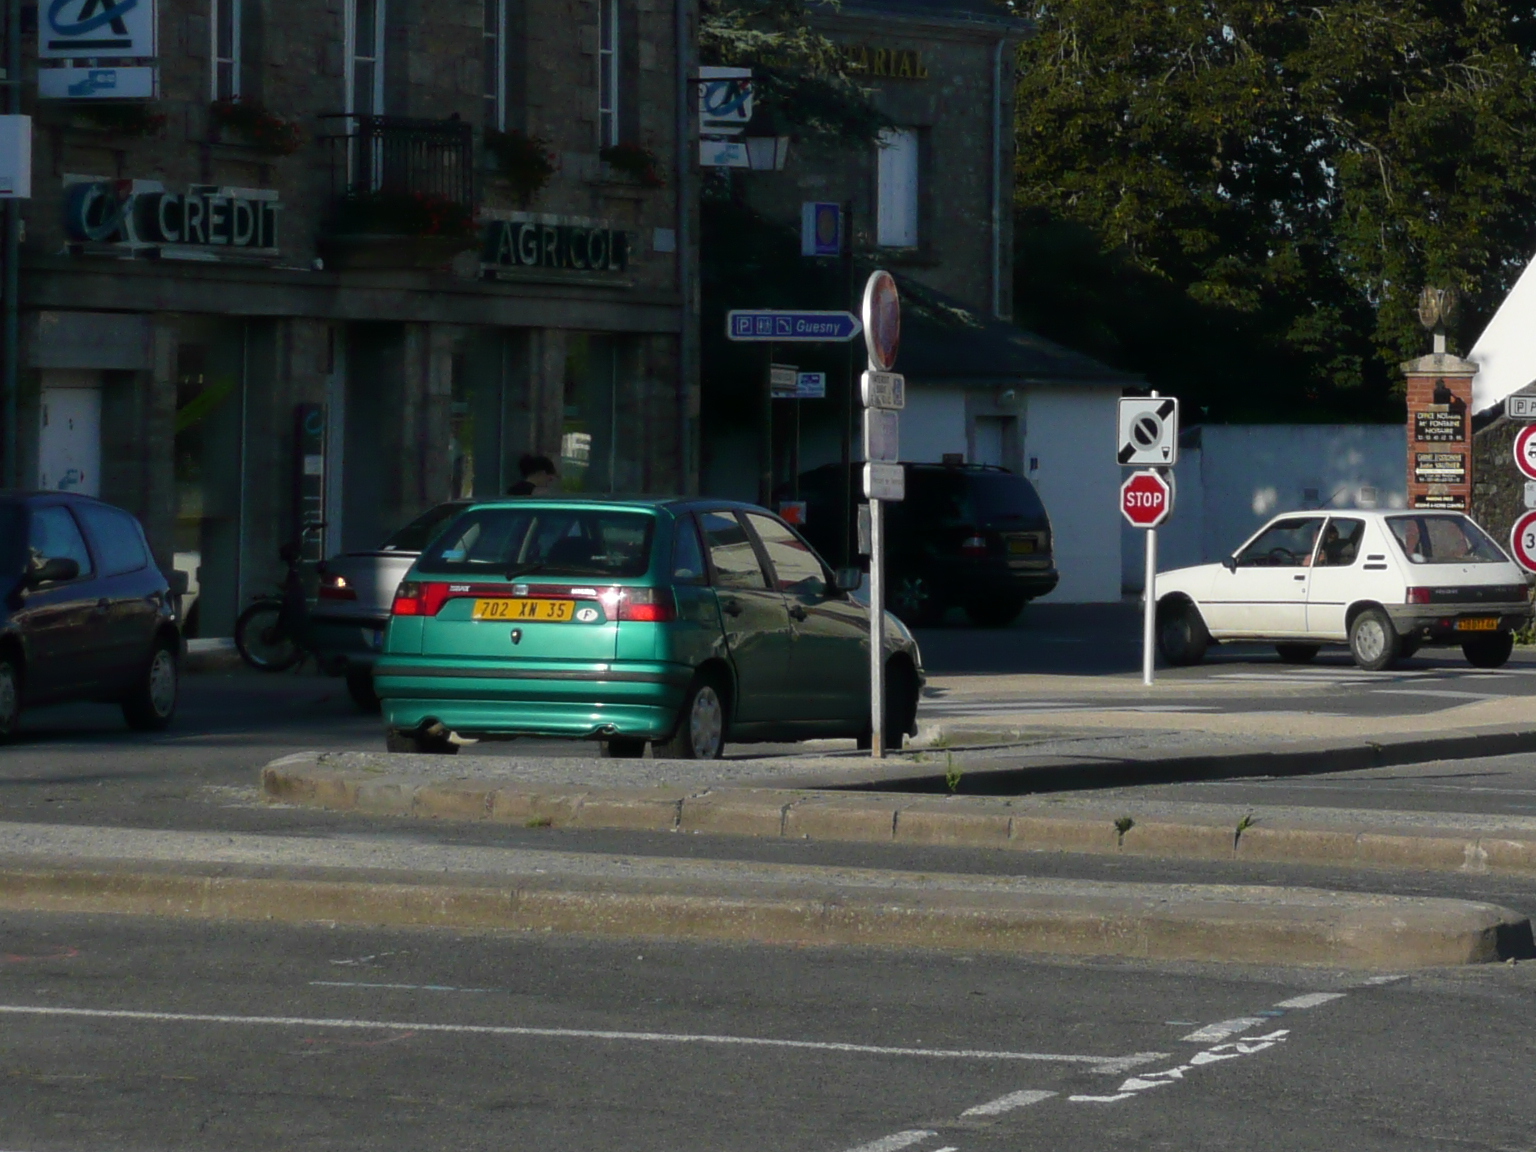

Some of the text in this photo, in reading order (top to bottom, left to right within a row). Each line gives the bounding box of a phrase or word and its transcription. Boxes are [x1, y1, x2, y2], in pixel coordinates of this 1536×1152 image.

[796, 319, 841, 336] Guesny
[1126, 491, 1162, 507] STOP
[482, 601, 567, 618] 702 XN 35
[583, 609, 593, 620] F
